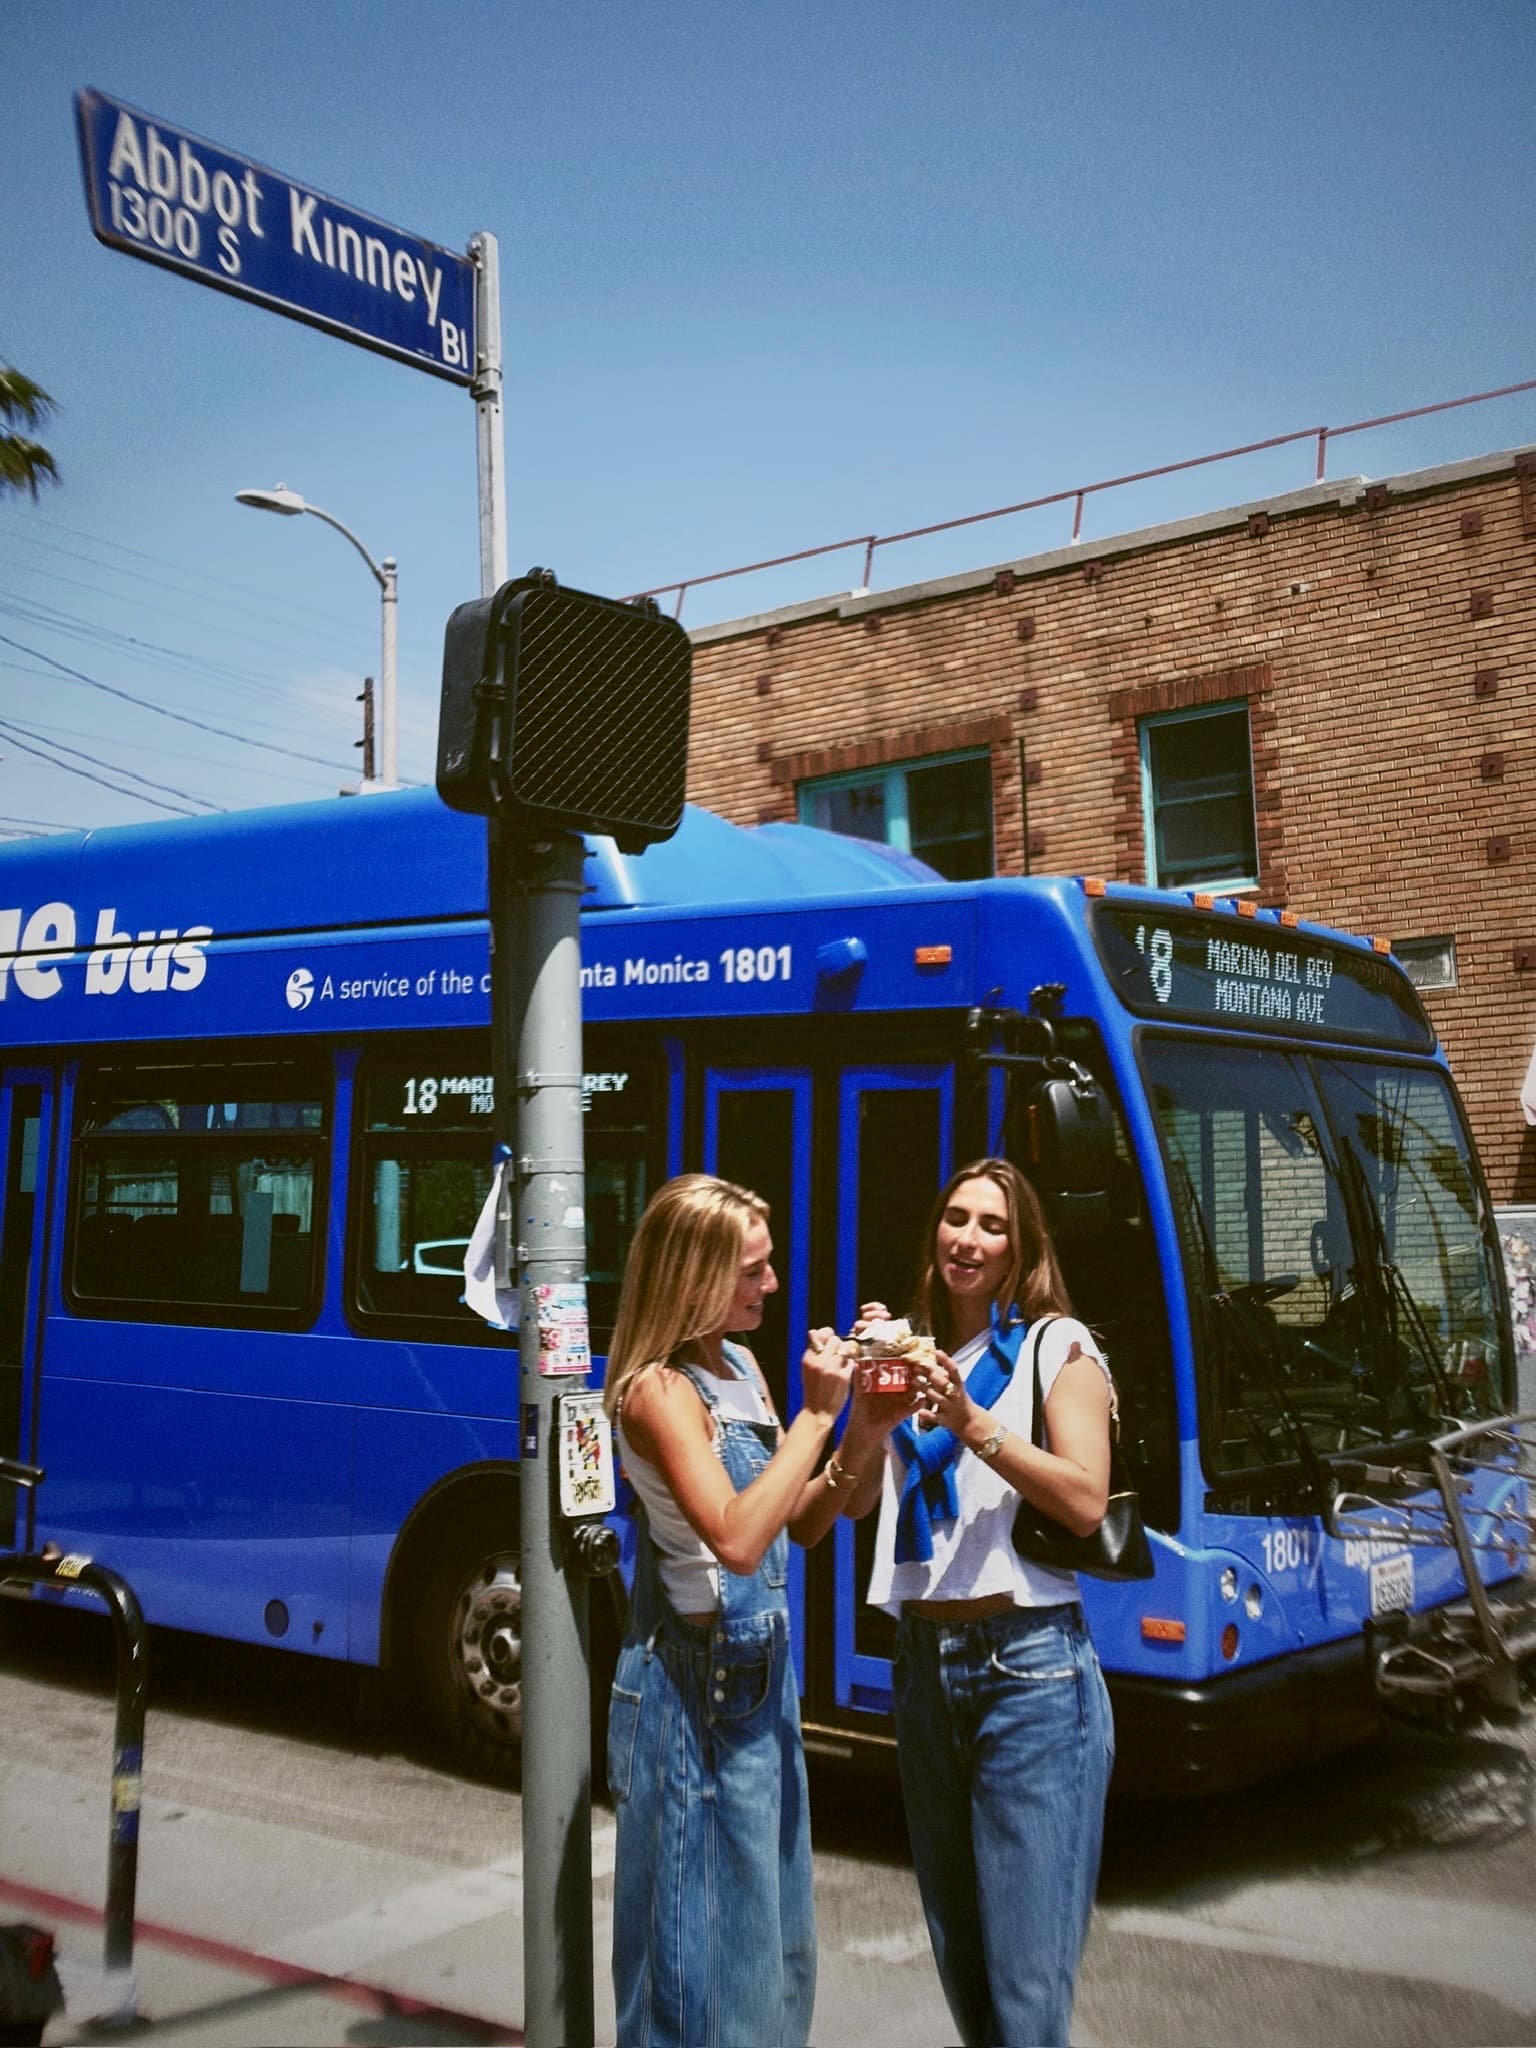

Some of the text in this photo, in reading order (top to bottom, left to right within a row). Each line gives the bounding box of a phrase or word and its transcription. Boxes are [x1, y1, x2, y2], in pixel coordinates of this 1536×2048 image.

[108, 181, 242, 277] 1300 S
[109, 110, 443, 327] Abbot Kinney
[85, 908, 214, 994] bus
[579, 945, 793, 990] nta Monica 1801
[1207, 938, 1333, 989] MARINA DEL REY
[320, 976, 334, 1000] A
[339, 972, 408, 1000] service
[416, 970, 436, 996] of
[440, 970, 473, 995] the
[1215, 978, 1325, 1023] MONTANA AVE
[403, 1077, 437, 1114] 18
[441, 1076, 494, 1094] MARI
[1262, 1524, 1310, 1574] 1801
